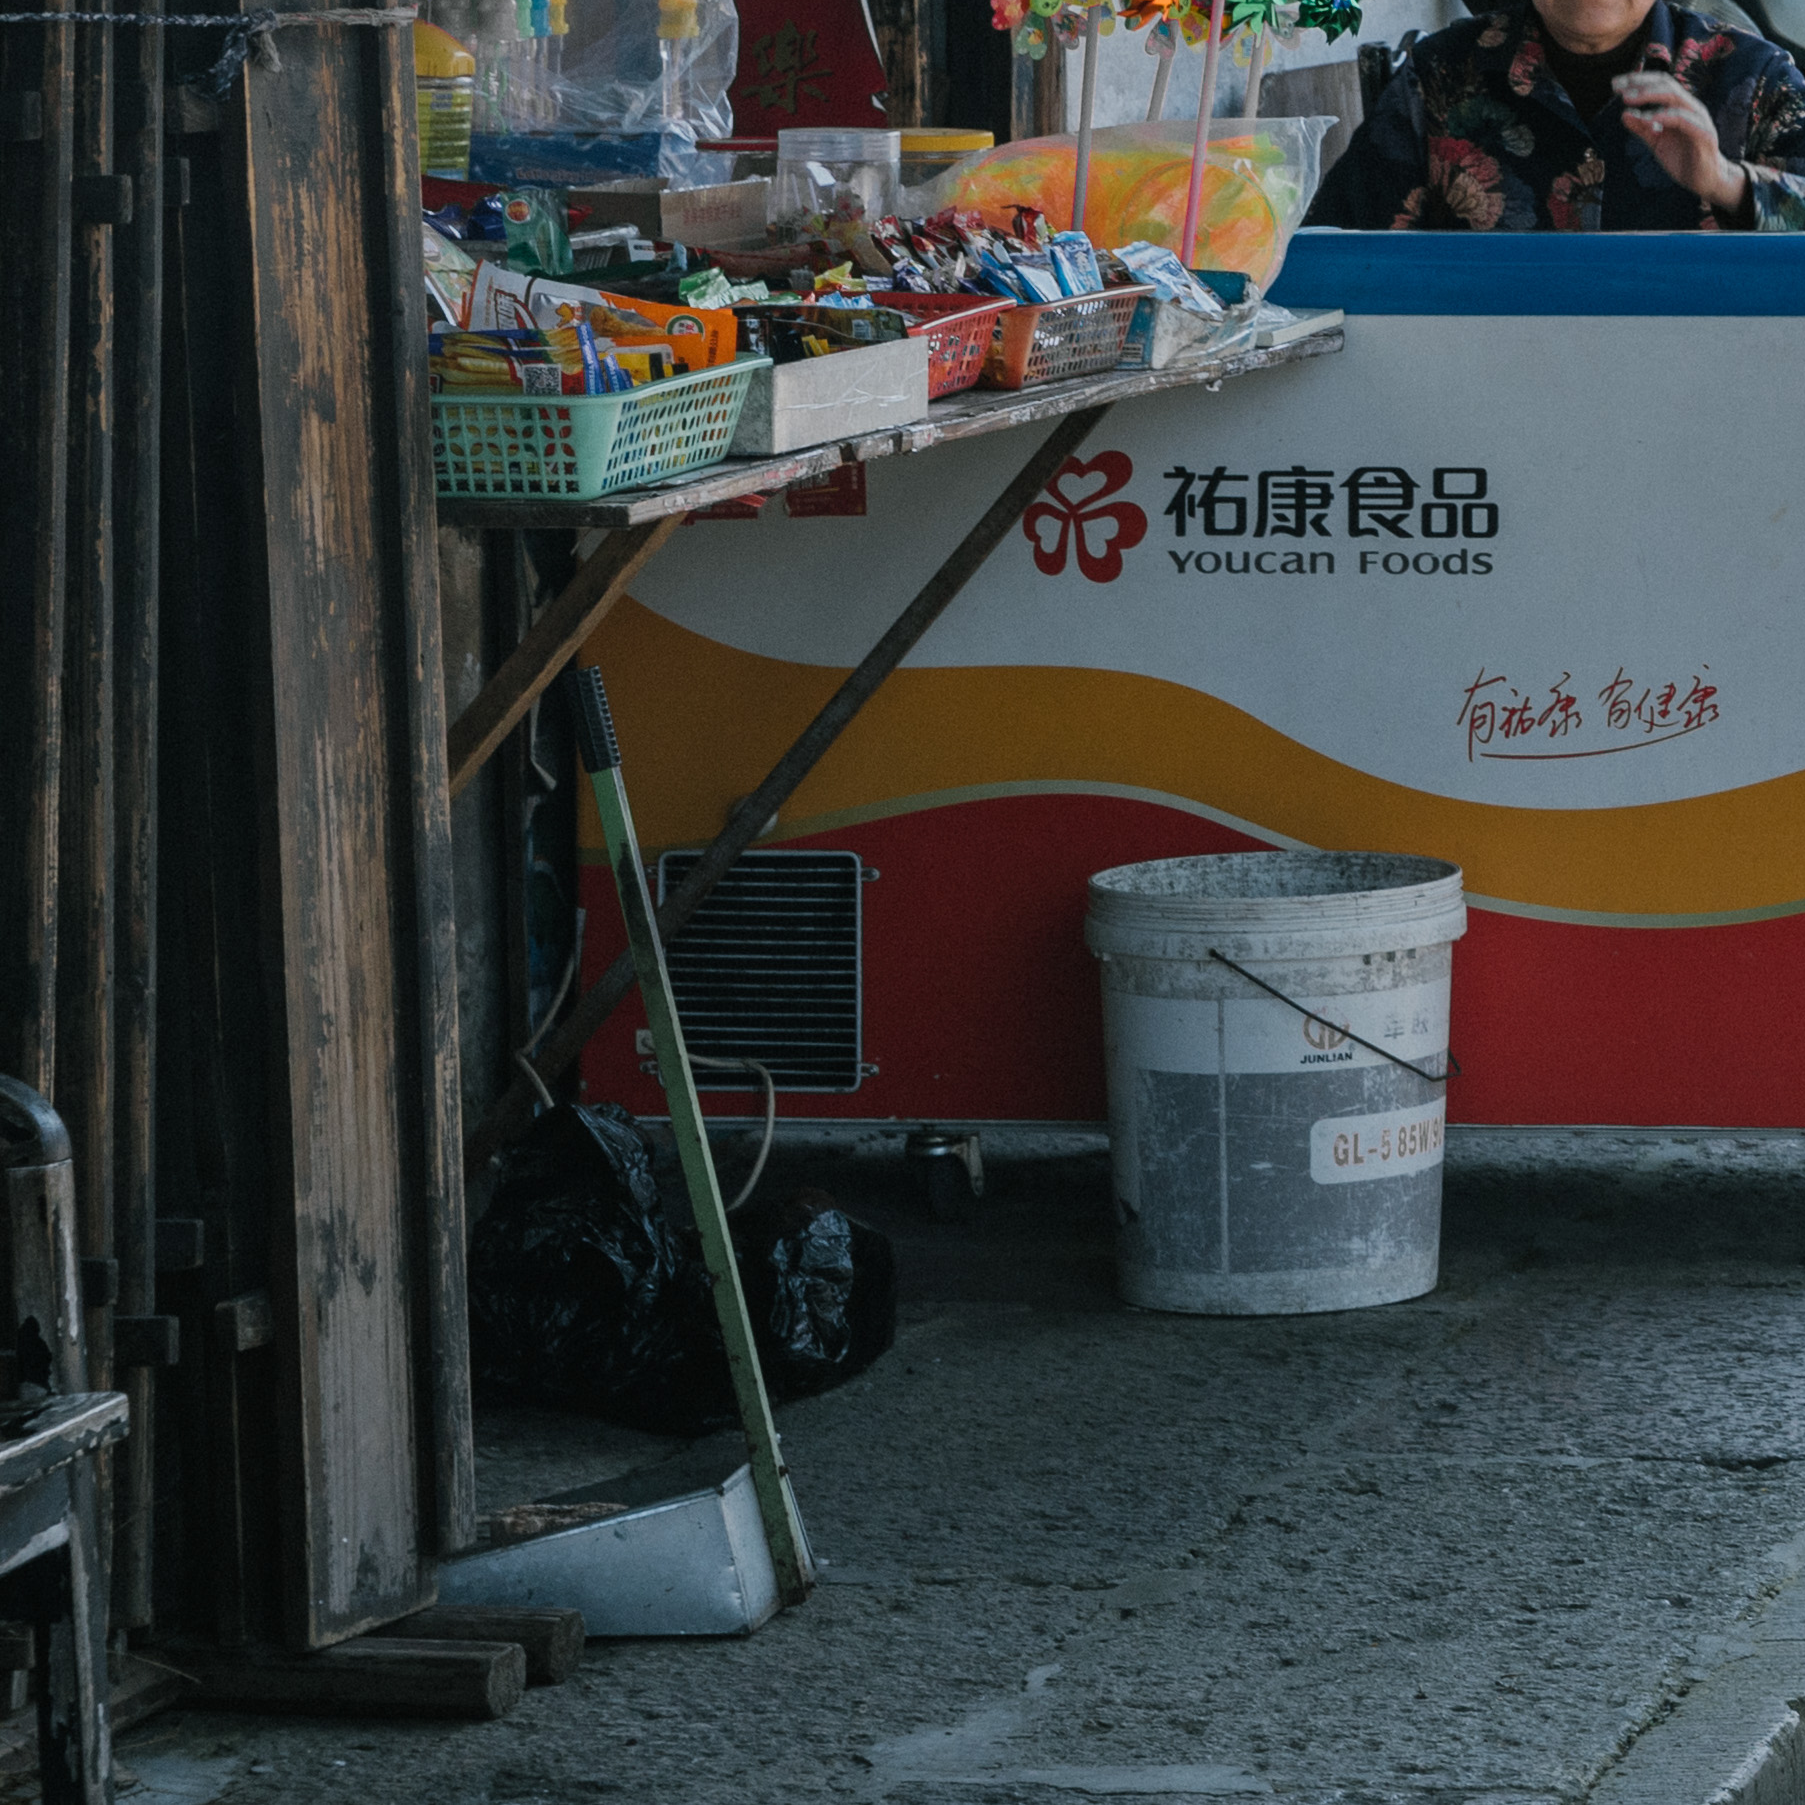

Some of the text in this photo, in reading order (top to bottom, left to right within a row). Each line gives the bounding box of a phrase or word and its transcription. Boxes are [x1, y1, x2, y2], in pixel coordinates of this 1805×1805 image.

[1163, 464, 1499, 540] 祐康食品
[1359, 547, 1494, 575] Foods
[1300, 1052, 1353, 1065] JUNLIAN
[1333, 1127, 1391, 1167] GL-5
